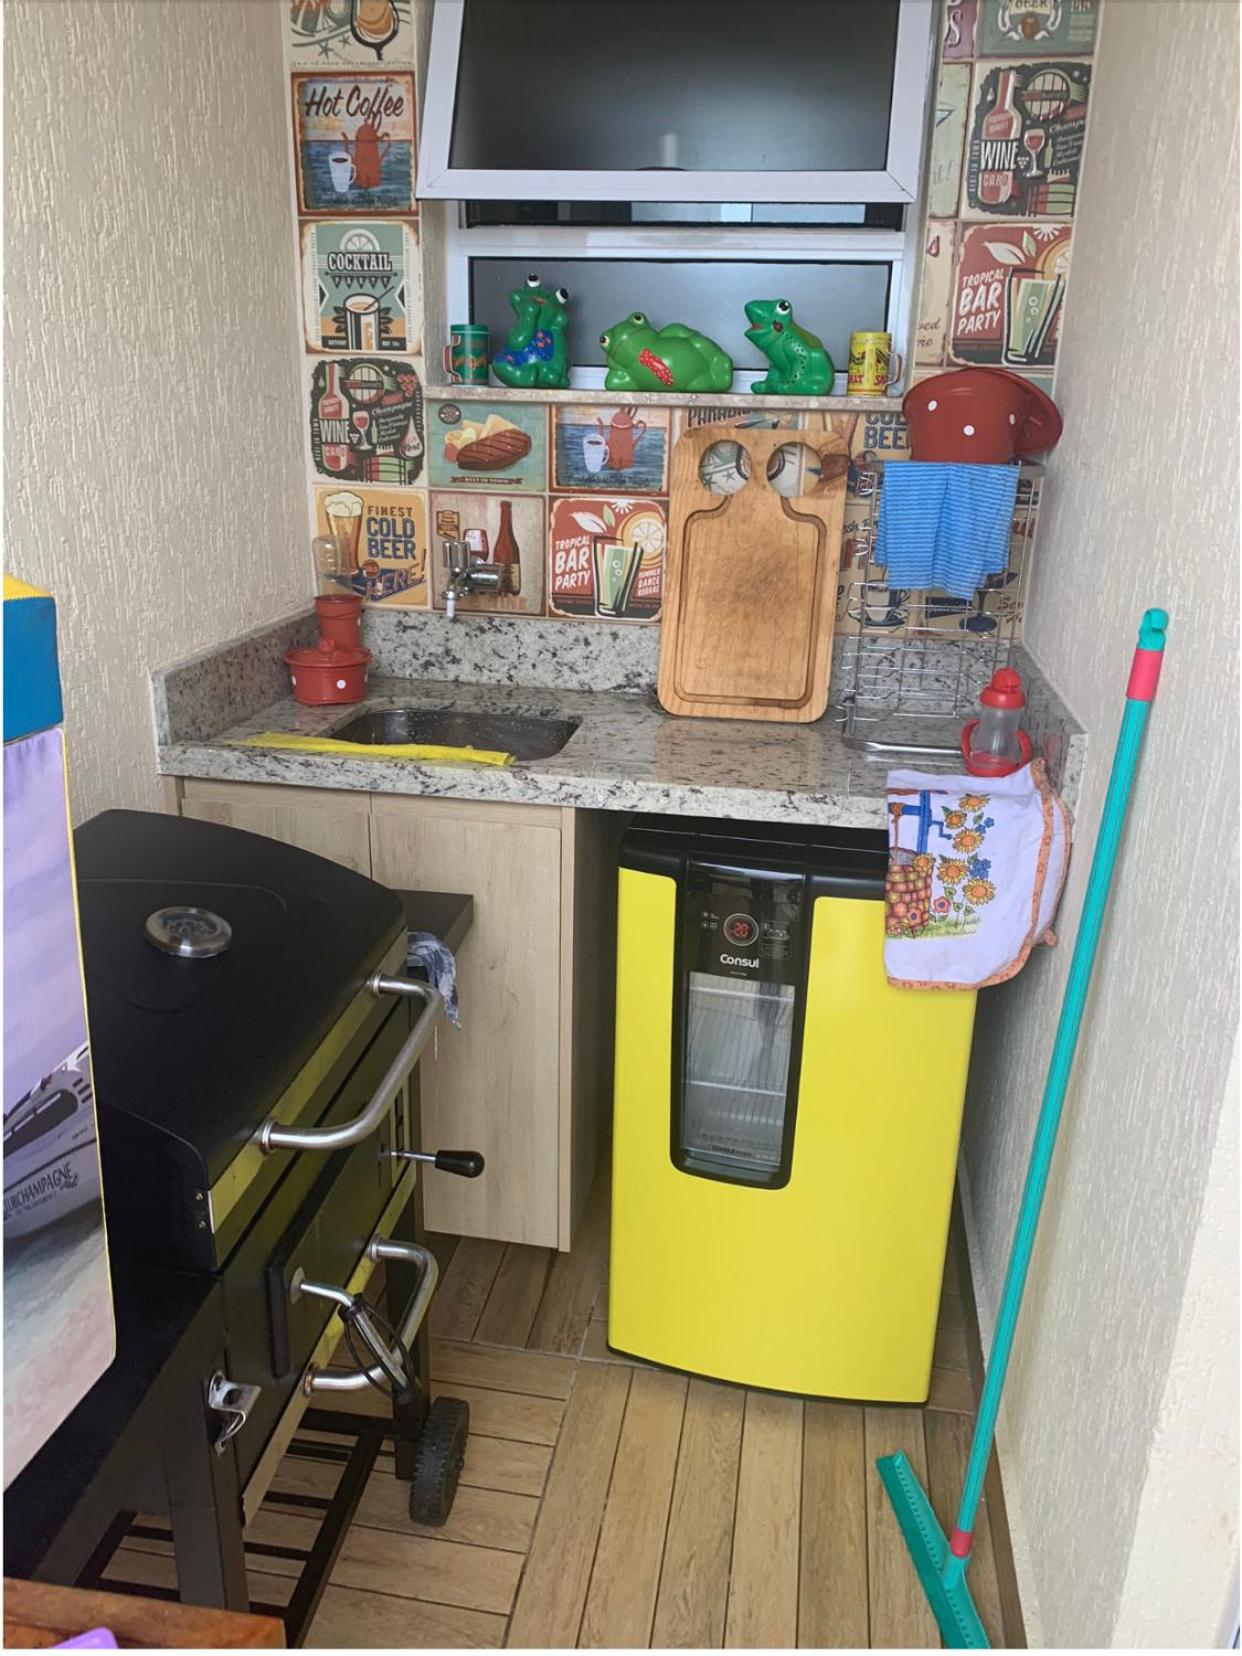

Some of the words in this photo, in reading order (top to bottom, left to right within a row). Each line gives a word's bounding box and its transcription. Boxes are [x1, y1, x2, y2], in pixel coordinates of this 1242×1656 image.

[305, 86, 344, 117] Hot
[346, 85, 405, 131] Coffee
[981, 141, 1019, 170] WINE
[328, 252, 393, 272] COCKTAIL
[962, 268, 1005, 288] TROPICAL
[958, 281, 1003, 316] BAR
[957, 309, 1002, 336] PARTY
[866, 411, 907, 425] COL
[320, 420, 350, 443] WINE
[864, 426, 909, 449] BEE
[367, 505, 413, 517] FINEST
[366, 517, 415, 539] COLD
[367, 538, 416, 560] BEER
[555, 535, 590, 551] TROPICAL
[555, 547, 589, 574] BAR
[555, 570, 591, 591] PARTY
[720, 954, 760, 968] Consul
